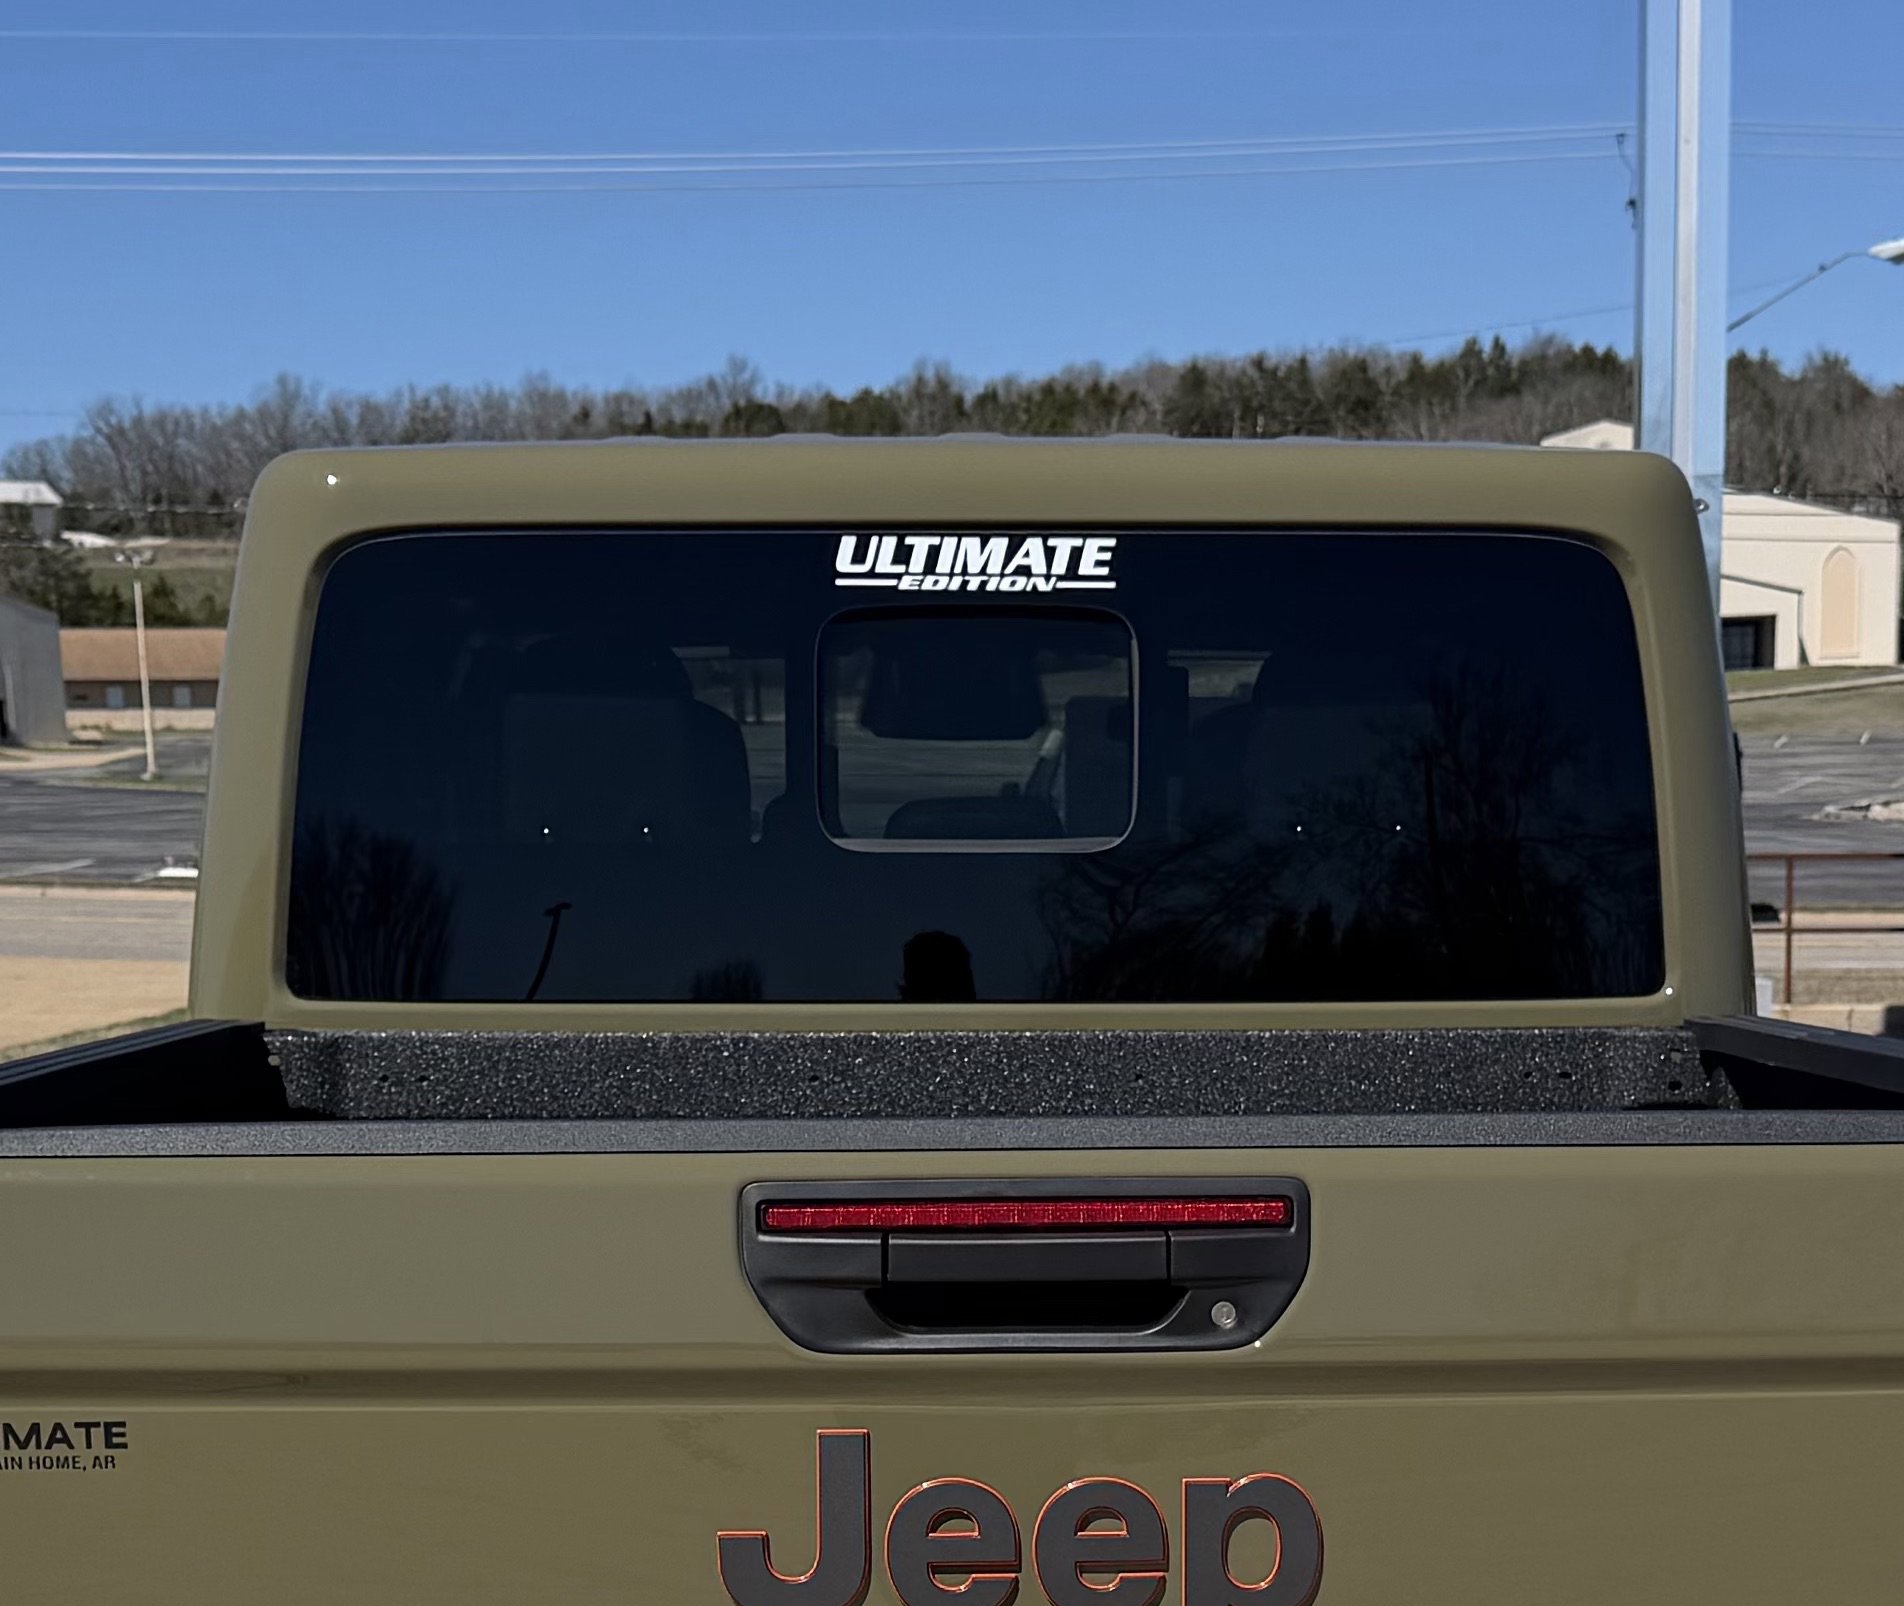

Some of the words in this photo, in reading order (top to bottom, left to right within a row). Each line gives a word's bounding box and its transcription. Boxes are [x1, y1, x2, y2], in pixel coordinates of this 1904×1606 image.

[834, 534, 1117, 576] ULTIMATE
[896, 574, 1059, 592] EDITION
[28, 1455, 87, 1472] HOME,
[92, 1454, 116, 1470] AR
